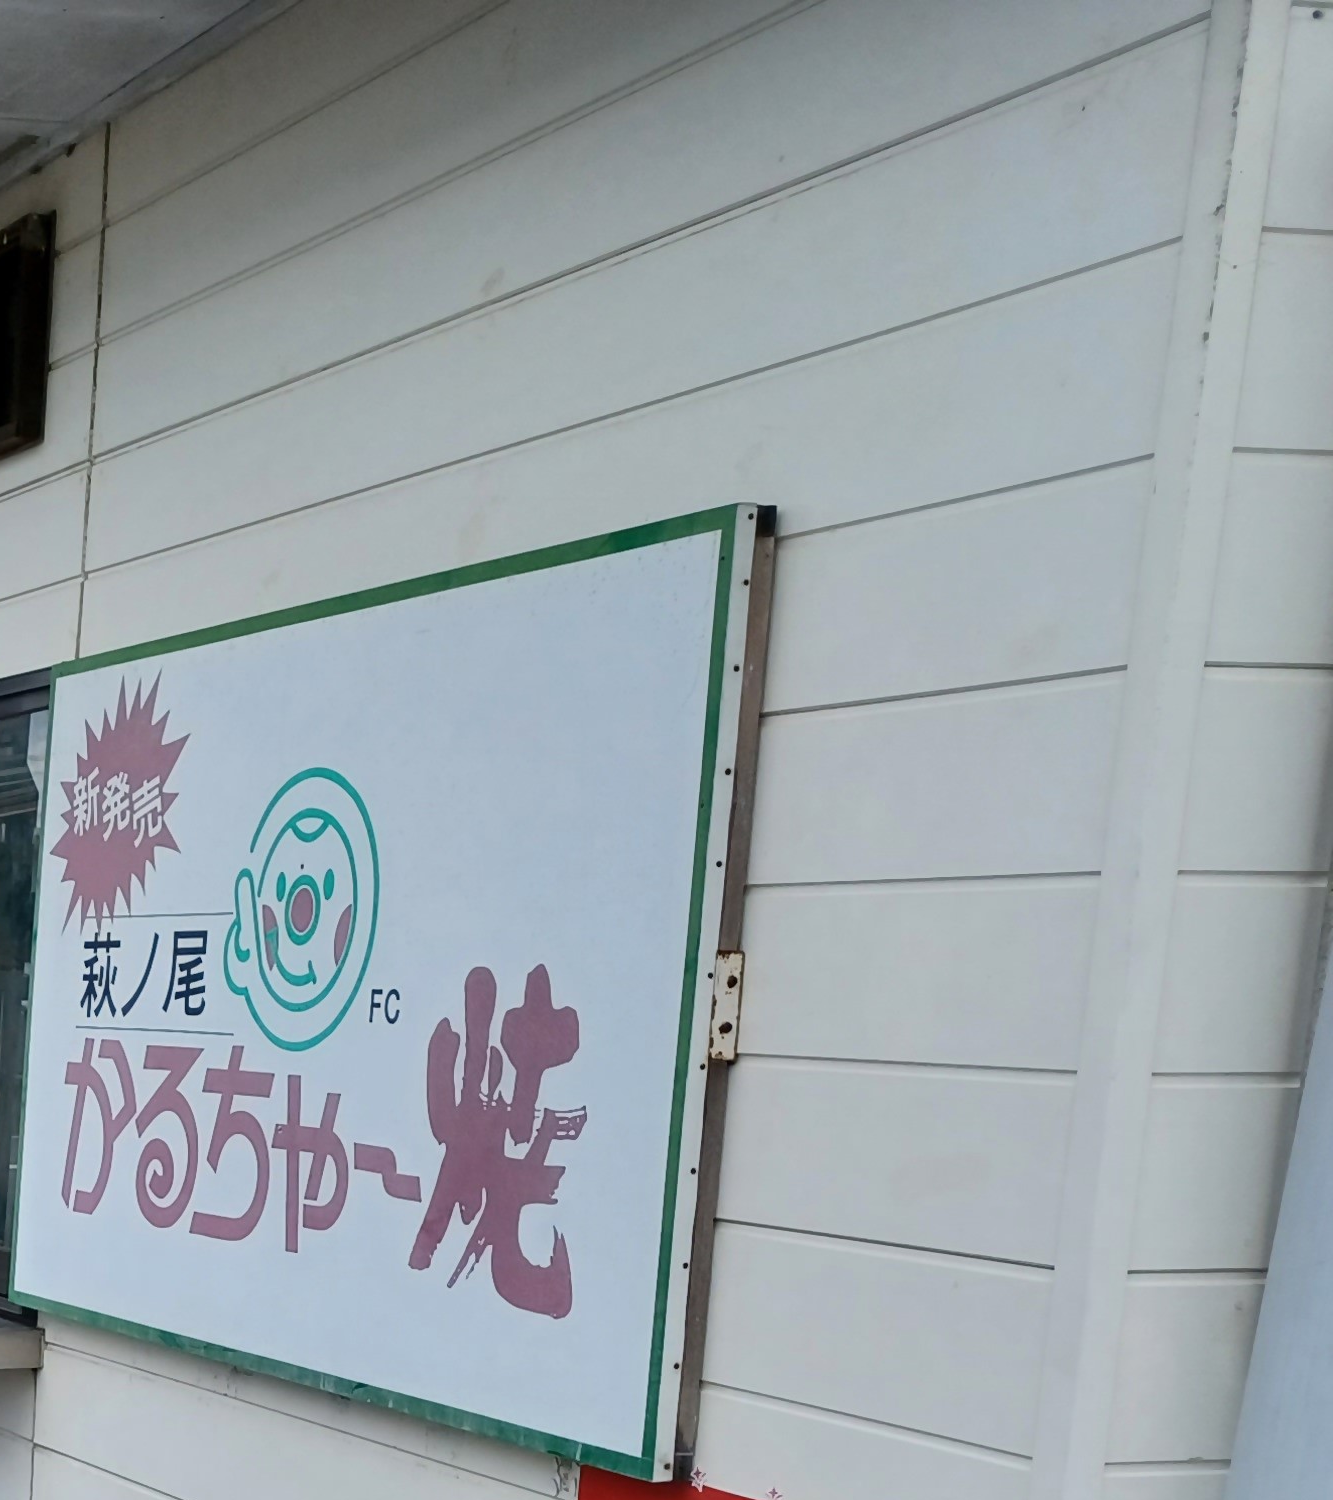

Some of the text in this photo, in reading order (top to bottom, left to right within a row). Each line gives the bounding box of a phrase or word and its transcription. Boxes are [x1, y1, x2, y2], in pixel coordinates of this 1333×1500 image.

[70, 767, 167, 848] 新発売
[79, 928, 210, 1020] 萩ノ尾
[368, 987, 401, 1025] FC
